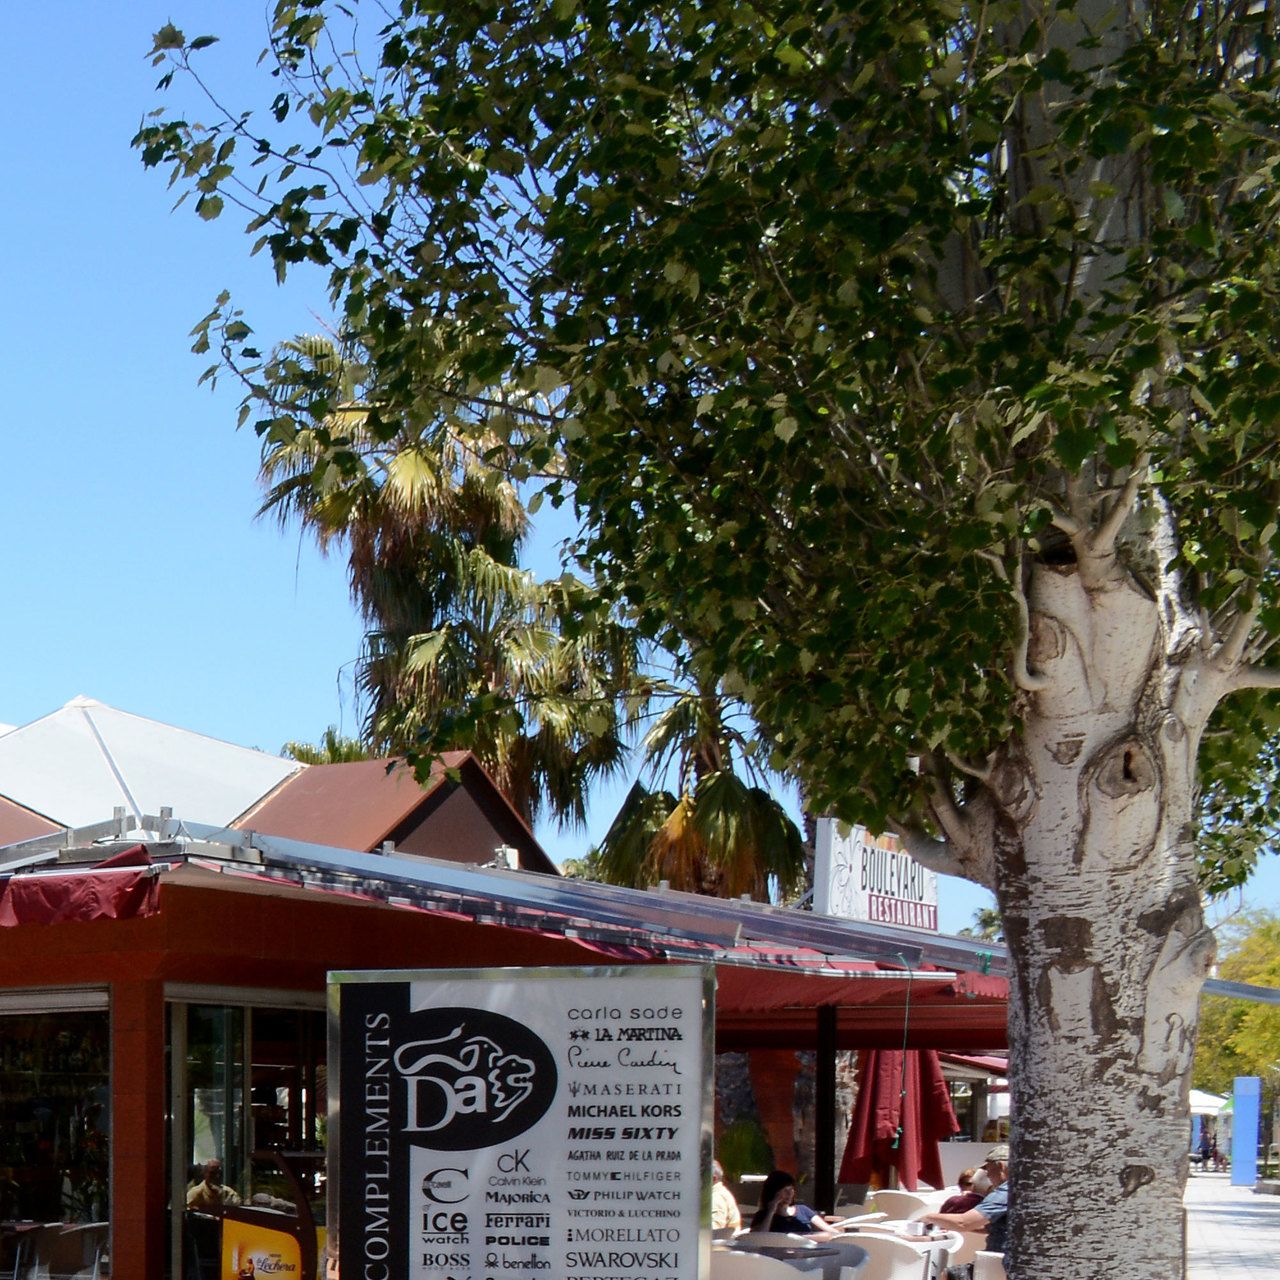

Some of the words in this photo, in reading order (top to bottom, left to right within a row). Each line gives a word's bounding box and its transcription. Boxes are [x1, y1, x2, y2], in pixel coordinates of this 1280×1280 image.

[871, 897, 935, 929] RESTAURANT
[567, 1007, 621, 1020] carla
[630, 1006, 682, 1020] sade
[617, 1027, 683, 1041] MARTINA
[583, 1083, 682, 1096] MASERATI
[567, 1105, 637, 1118] MICHAEL
[641, 1104, 682, 1118] KORS
[567, 1127, 616, 1140] MISS
[621, 1127, 678, 1140] SIXTY
[567, 1150, 601, 1161] AGATHA
[606, 1151, 625, 1161] RUIZ
[628, 1151, 639, 1160] DE
[642, 1151, 653, 1160] LA
[656, 1150, 681, 1161] PRADA
[488, 1176, 521, 1187] Calvin
[522, 1176, 546, 1186] Klein
[566, 1171, 610, 1181] TOMMY
[623, 1171, 681, 1181] HILFIGER
[594, 1191, 633, 1201] PHILIP
[636, 1191, 680, 1201] WATCH
[485, 1213, 551, 1228] Ferrari
[567, 1209, 616, 1218] VICTORIO
[618, 1210, 625, 1218] &
[628, 1209, 681, 1218] LUCCHINO
[423, 1212, 468, 1232] ice
[422, 1233, 469, 1244] watch
[485, 1236, 550, 1246] POLICE
[576, 1228, 680, 1242] MORELLATO
[422, 1253, 470, 1267] BOSS
[503, 1253, 551, 1269] benetton
[566, 1252, 679, 1268] SWAROVSKI
